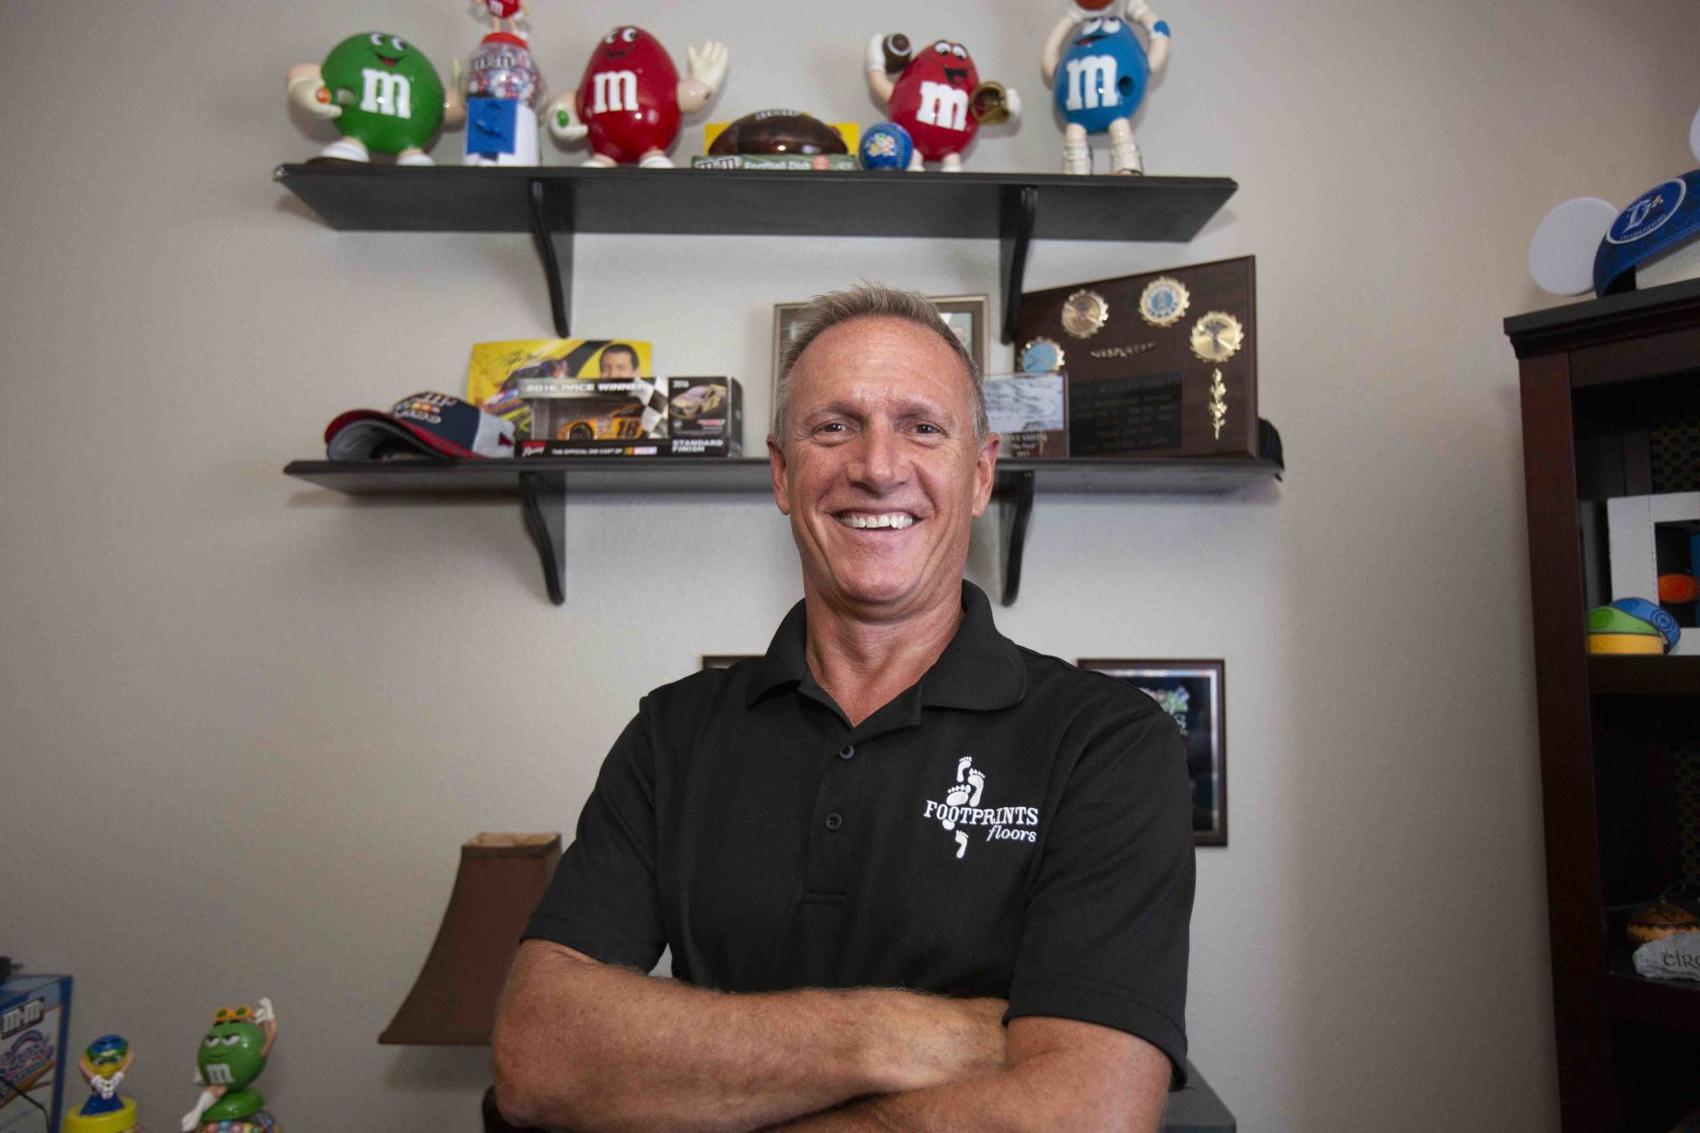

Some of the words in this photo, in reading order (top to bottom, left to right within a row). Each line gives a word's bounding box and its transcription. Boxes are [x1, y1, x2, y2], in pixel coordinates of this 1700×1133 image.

[361, 68, 411, 118] m
[593, 70, 638, 114] m
[916, 80, 969, 131] m
[1066, 55, 1119, 110] m
[924, 800, 1038, 825] FOOTPRINTS
[986, 825, 1037, 842] floors
